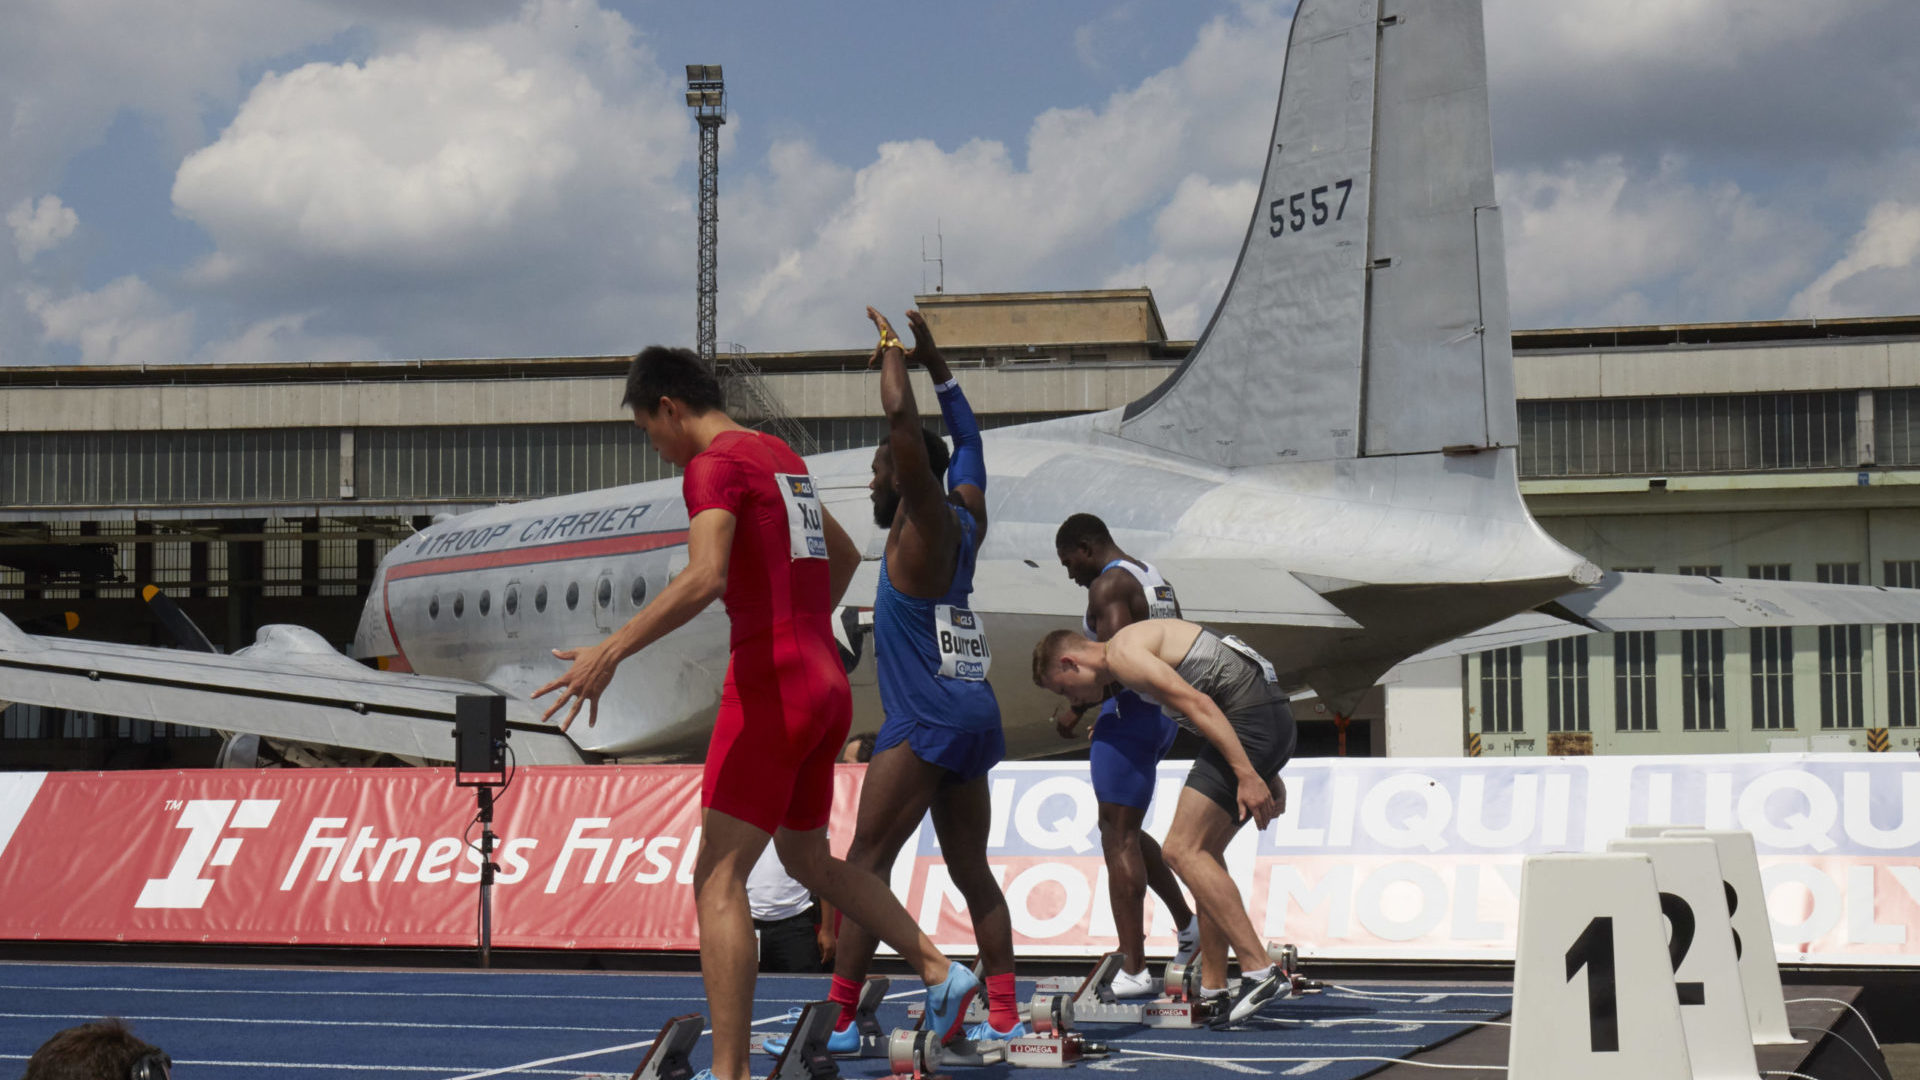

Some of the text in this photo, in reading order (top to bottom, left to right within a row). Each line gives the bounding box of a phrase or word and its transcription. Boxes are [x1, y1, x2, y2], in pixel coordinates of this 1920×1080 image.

[1270, 178, 1353, 238] 5557
[429, 504, 652, 555] TROOP CARRIER
[798, 503, 822, 530] Xu
[940, 630, 990, 658] Burrell
[164, 800, 183, 811] TM
[1275, 771, 1573, 852] LIQUI
[279, 817, 539, 891] Fitness
[1658, 892, 1705, 1005] 2
[1565, 916, 1619, 1052] 1
[1024, 1045, 1052, 1053] OMEGA
